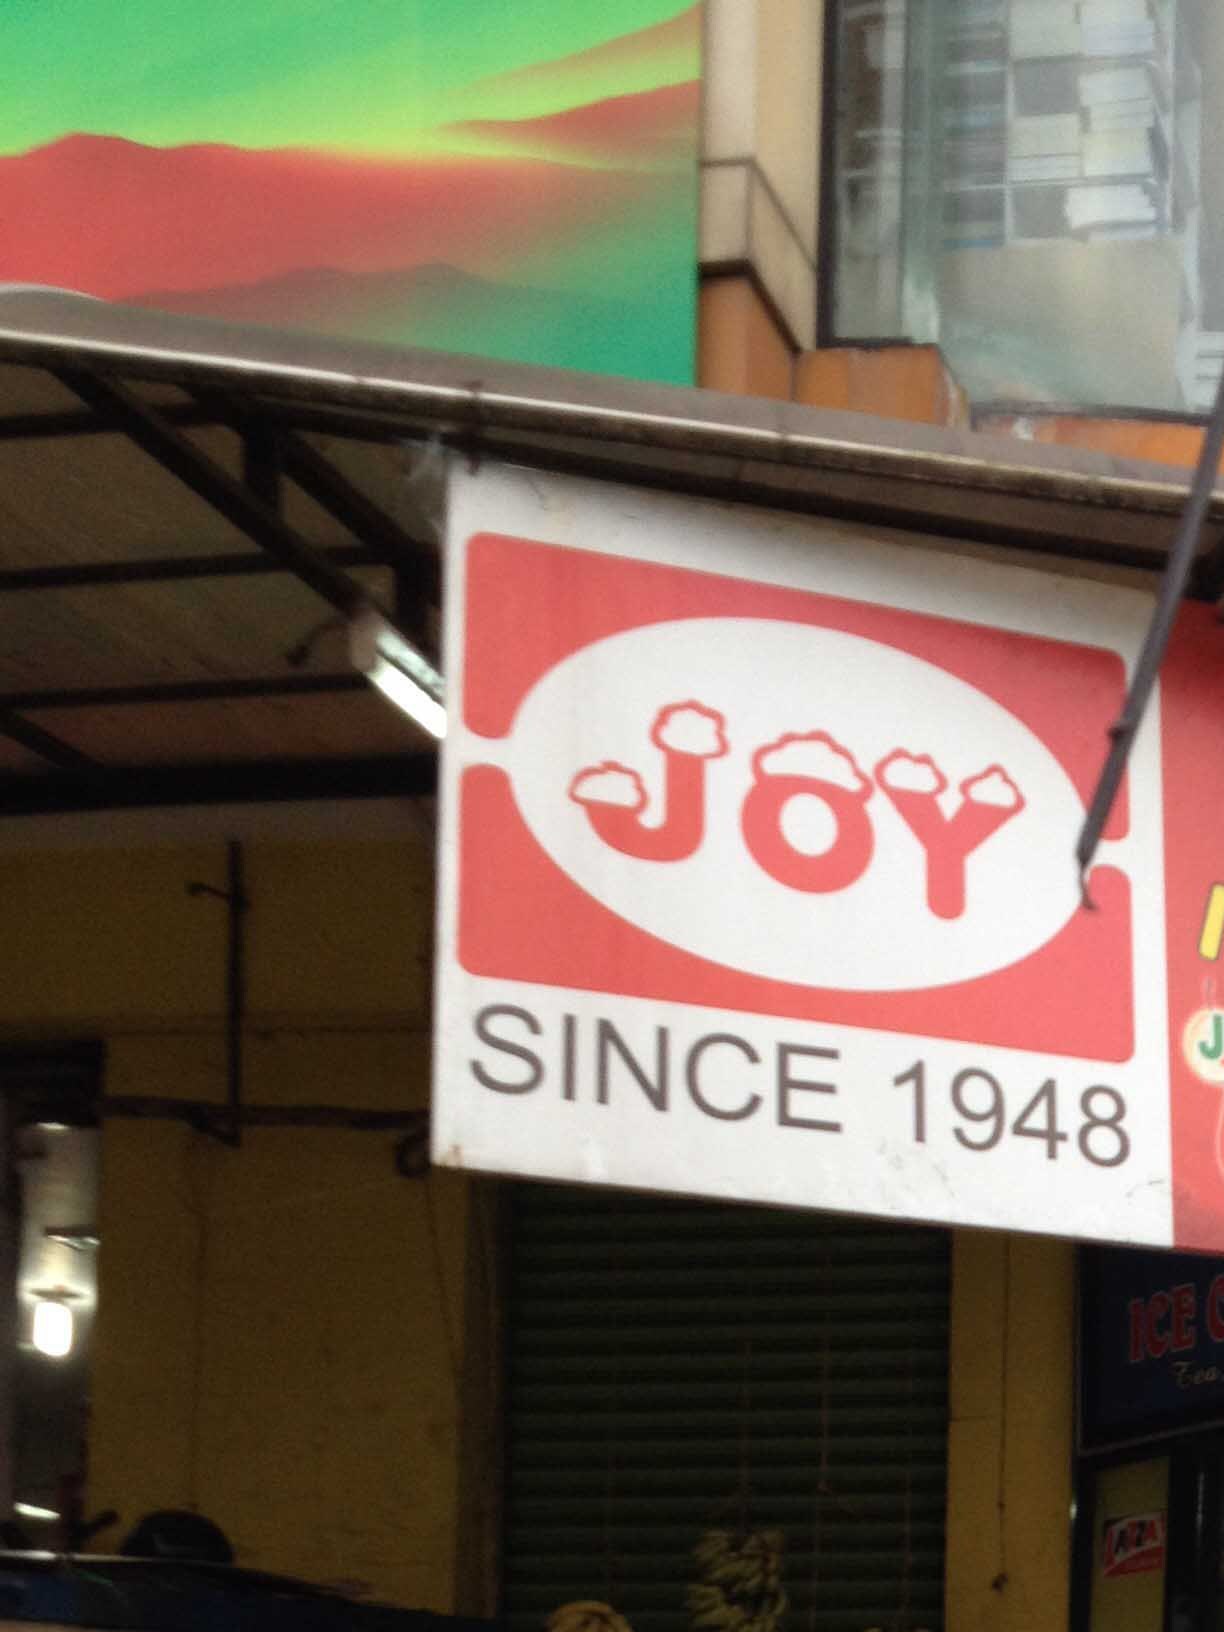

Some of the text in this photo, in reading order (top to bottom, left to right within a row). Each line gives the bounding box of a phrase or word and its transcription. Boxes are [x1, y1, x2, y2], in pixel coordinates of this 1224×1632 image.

[570, 699, 1025, 920] JOY
[467, 1004, 1131, 1168] SINCE 1948
[1129, 1283, 1196, 1362] ICE
